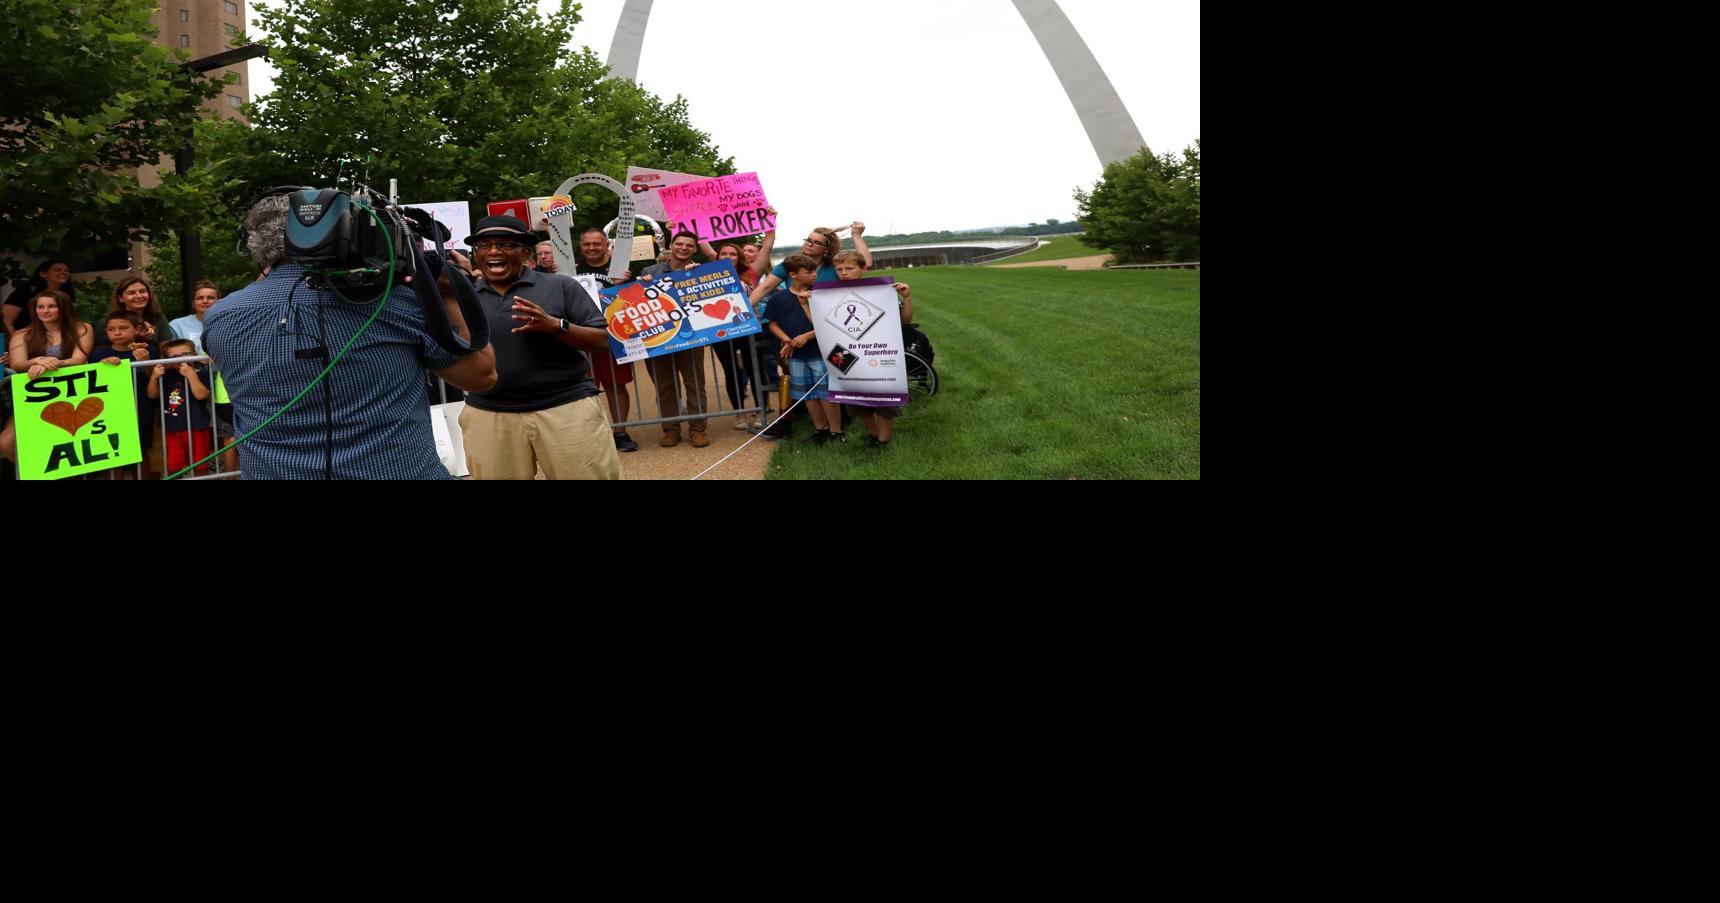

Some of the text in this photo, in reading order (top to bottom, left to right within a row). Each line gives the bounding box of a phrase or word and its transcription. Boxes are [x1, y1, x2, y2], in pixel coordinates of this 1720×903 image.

[662, 188, 677, 199] MY
[682, 179, 733, 199] FAVORITE
[719, 190, 762, 203] MY DOGS
[545, 204, 576, 218] TODAY
[710, 207, 774, 238] ROKER
[644, 276, 675, 300] OFS
[674, 270, 731, 290] FREE MEALS
[686, 276, 736, 294] ACTIVITIES
[680, 287, 725, 303] FOR KIDS!
[614, 299, 662, 324] FOOD
[668, 301, 703, 321] OFS
[623, 309, 669, 334] & FUN
[639, 325, 666, 339] CLUB
[24, 369, 109, 402] STL
[44, 433, 119, 473] AL!
